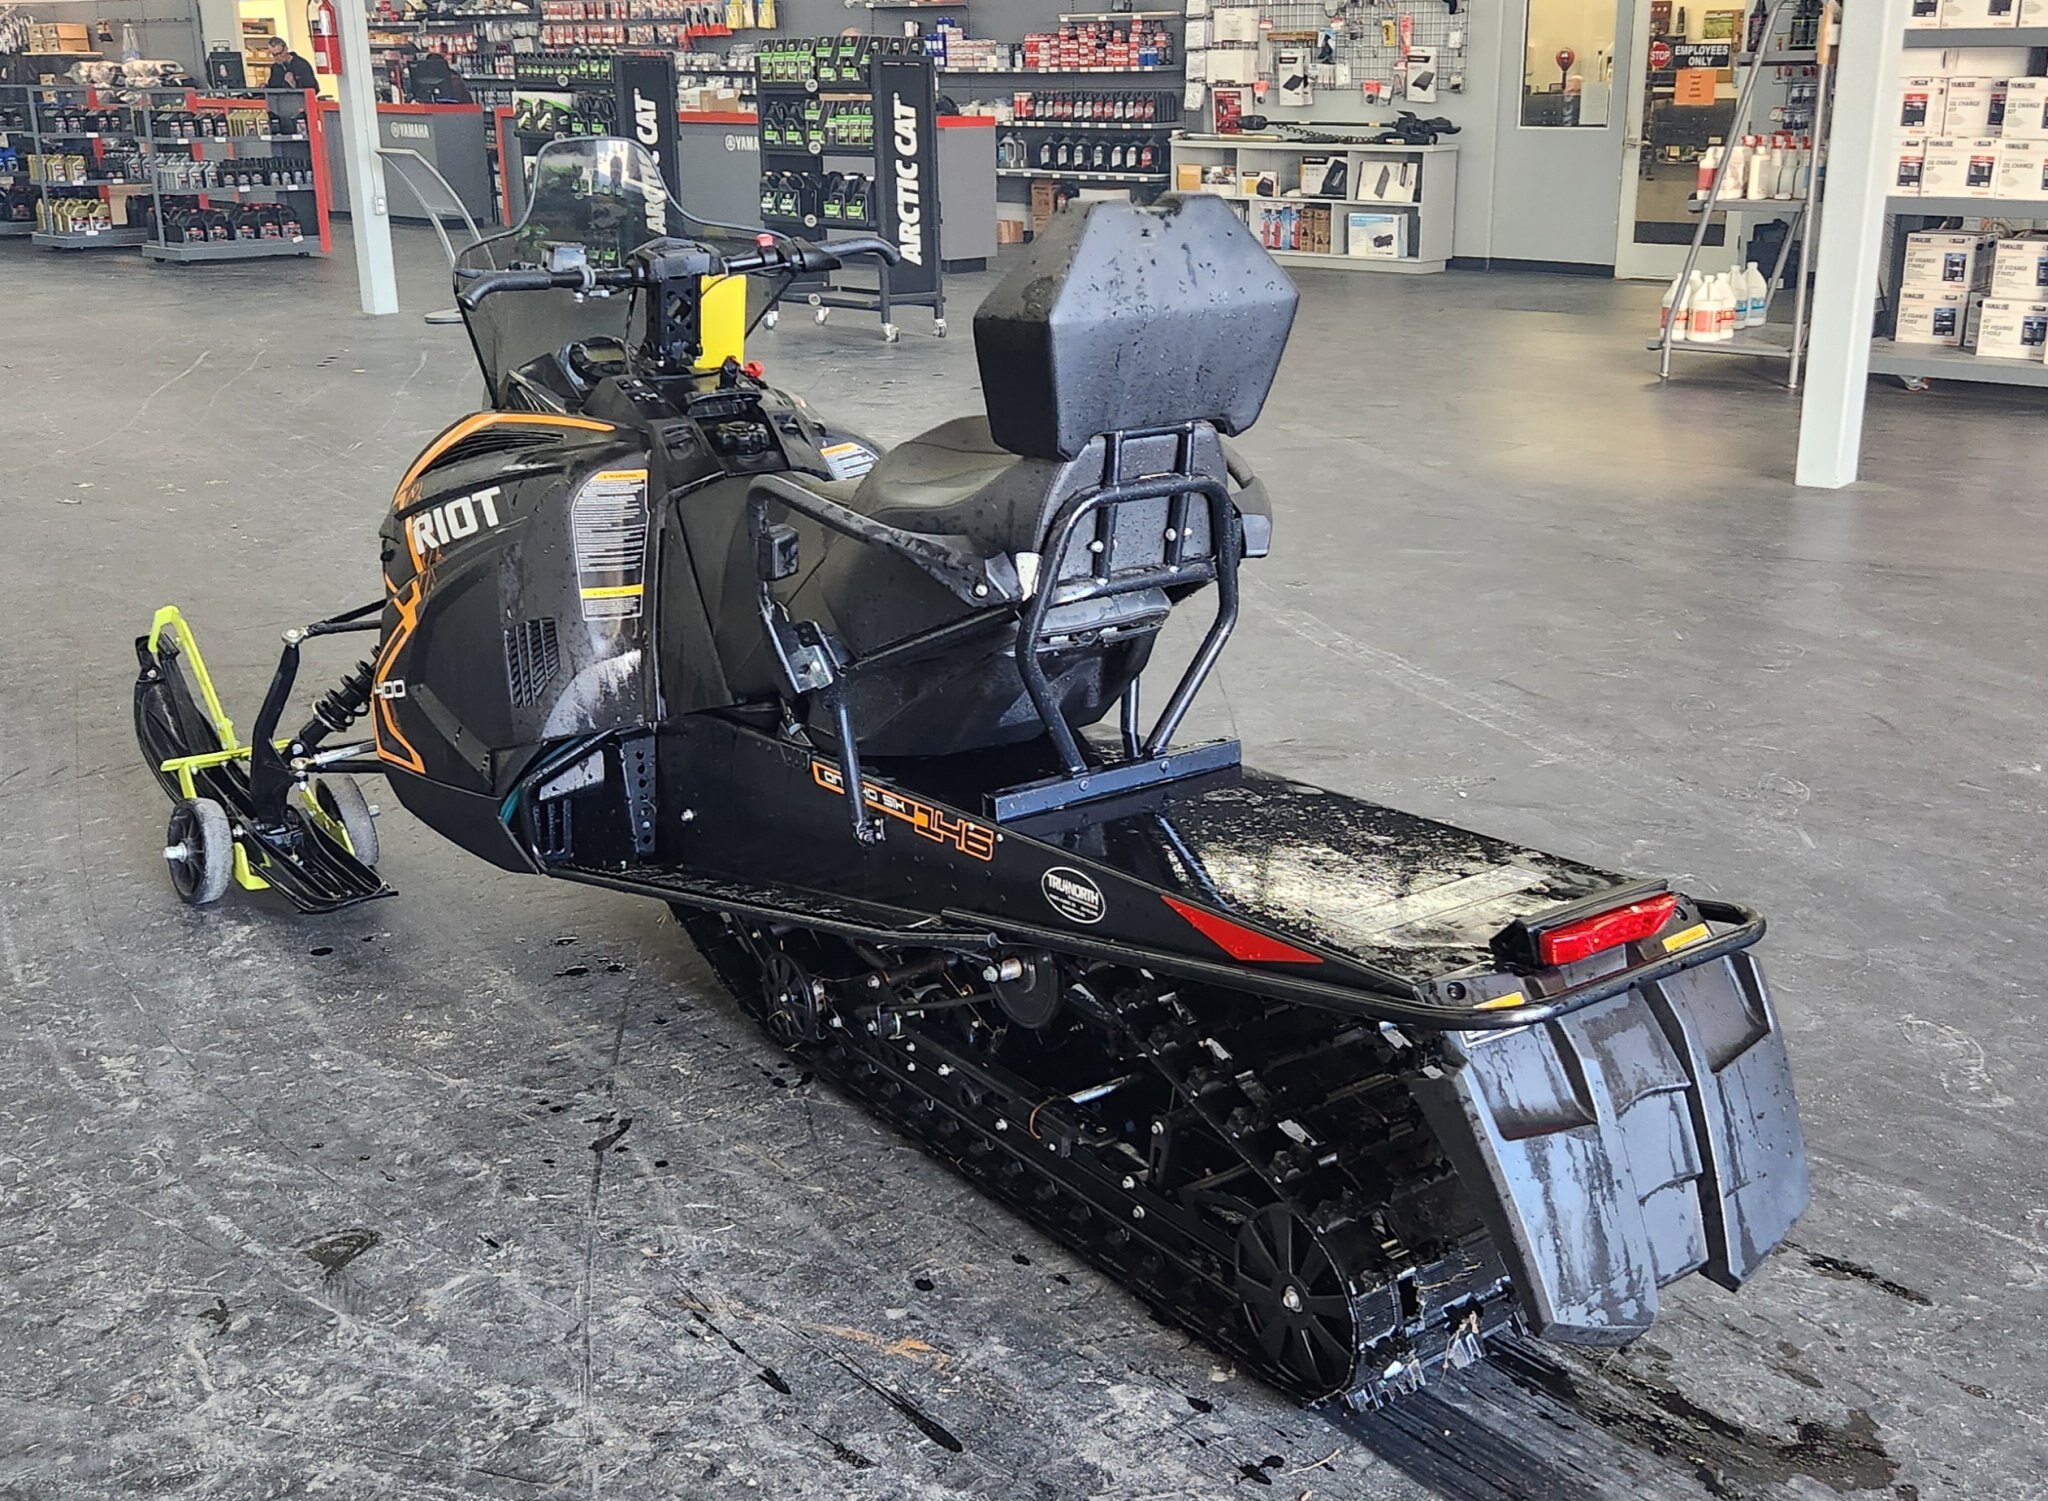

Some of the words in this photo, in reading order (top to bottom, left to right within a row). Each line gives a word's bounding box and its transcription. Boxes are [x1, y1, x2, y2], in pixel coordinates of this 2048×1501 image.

[1650, 51, 1671, 61] STOP
[1675, 45, 1728, 56] EMPLOYEES
[1688, 56, 1713, 66] ONLY
[634, 95, 660, 145] CAT
[893, 99, 919, 157] CAT
[398, 122, 431, 139] YAMAHA
[735, 135, 760, 152] YAMA
[895, 159, 922, 267] ARCTIC
[413, 486, 501, 555] RIOT
[882, 794, 906, 813] SIX
[914, 804, 995, 862] 146
